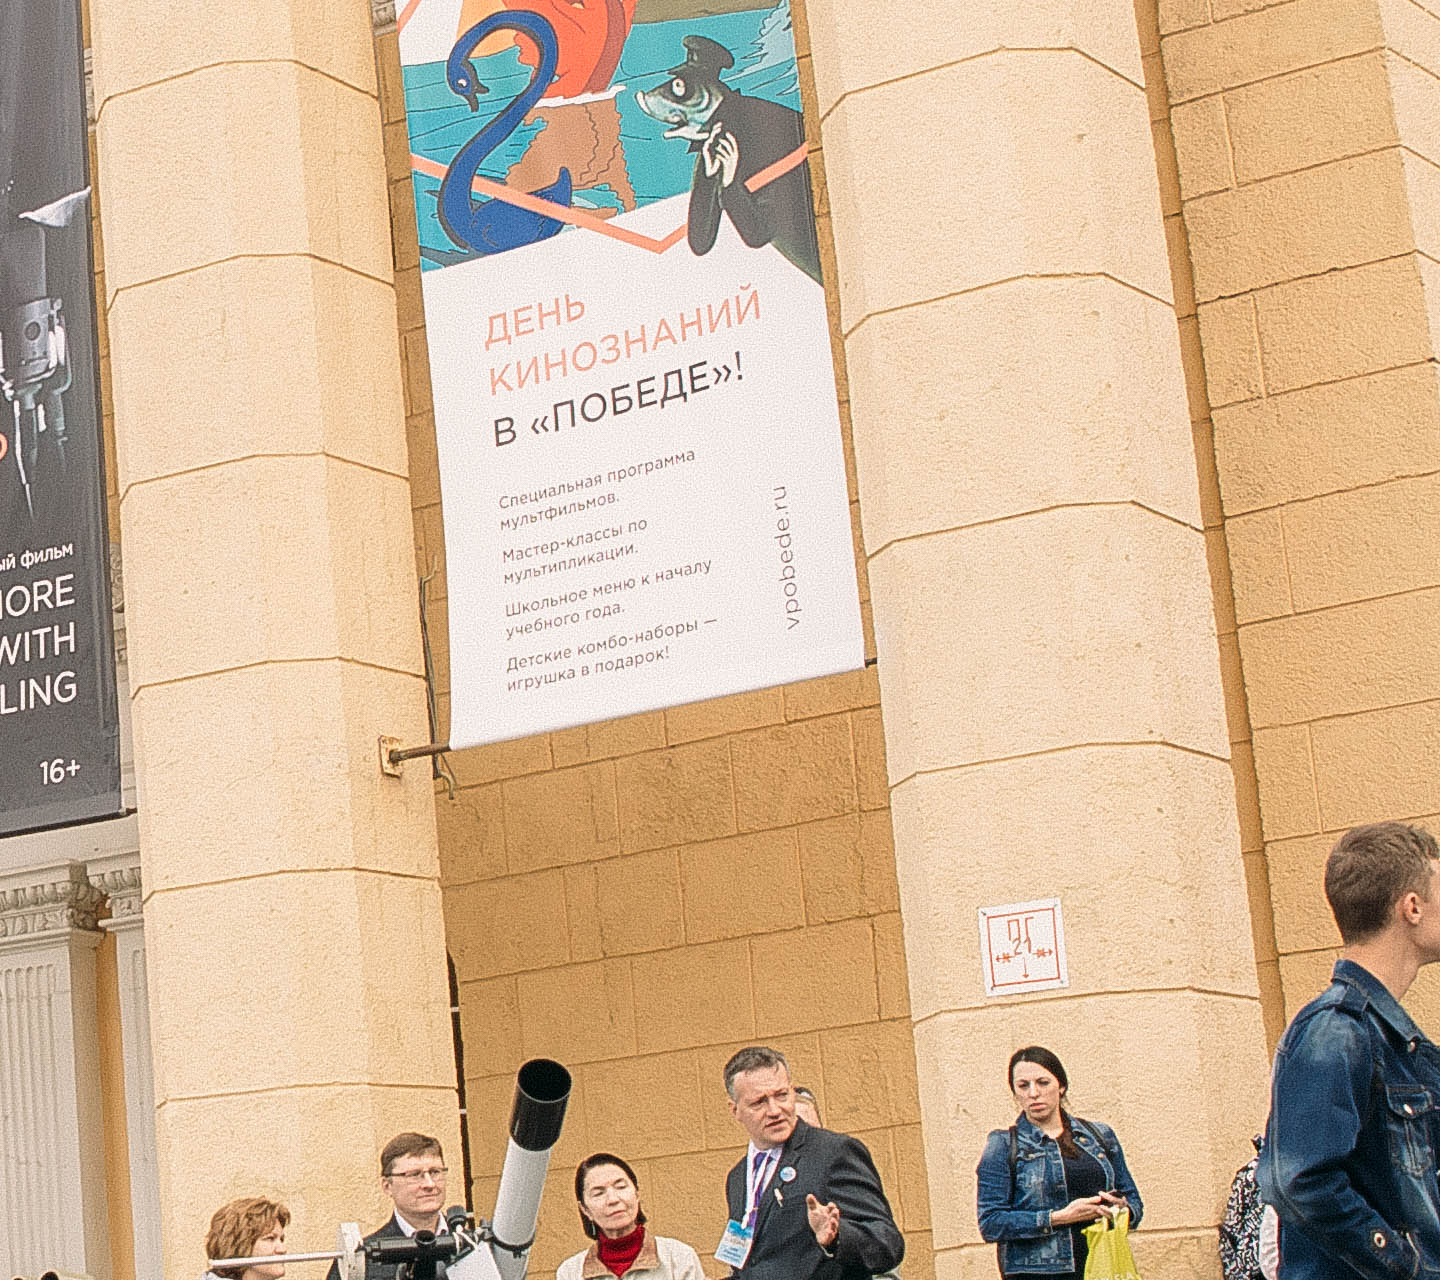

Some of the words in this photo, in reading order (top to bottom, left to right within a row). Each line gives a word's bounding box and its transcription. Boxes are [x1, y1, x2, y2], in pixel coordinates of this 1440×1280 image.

[484, 294, 585, 351] ДЕНЬ
[489, 283, 760, 396] КИНОЗНАНИЙ
[494, 417, 517, 447] В
[531, 351, 743, 435] «ПОБЕДЕ»!
[499, 474, 602, 509] Специальная
[607, 450, 696, 483] программа
[500, 492, 620, 531] мультфильмов.
[20, 543, 73, 570] фильм
[502, 525, 623, 564] Мастер-классы
[628, 519, 648, 533] по
[504, 543, 639, 585] мультипликации.
[773, 486, 803, 630] vpobede.ru
[505, 588, 588, 617] Школьное
[593, 577, 636, 597] меню
[641, 575, 651, 585] к
[655, 559, 712, 583] началу
[505, 611, 580, 640] учебного
[585, 602, 626, 621] года.
[506, 646, 572, 674] Детские
[577, 619, 698, 656] комбо-наборы
[507, 667, 576, 692] игрушка
[581, 665, 590, 676] в
[595, 645, 670, 674] подарок!
[39, 758, 81, 785] 16+
